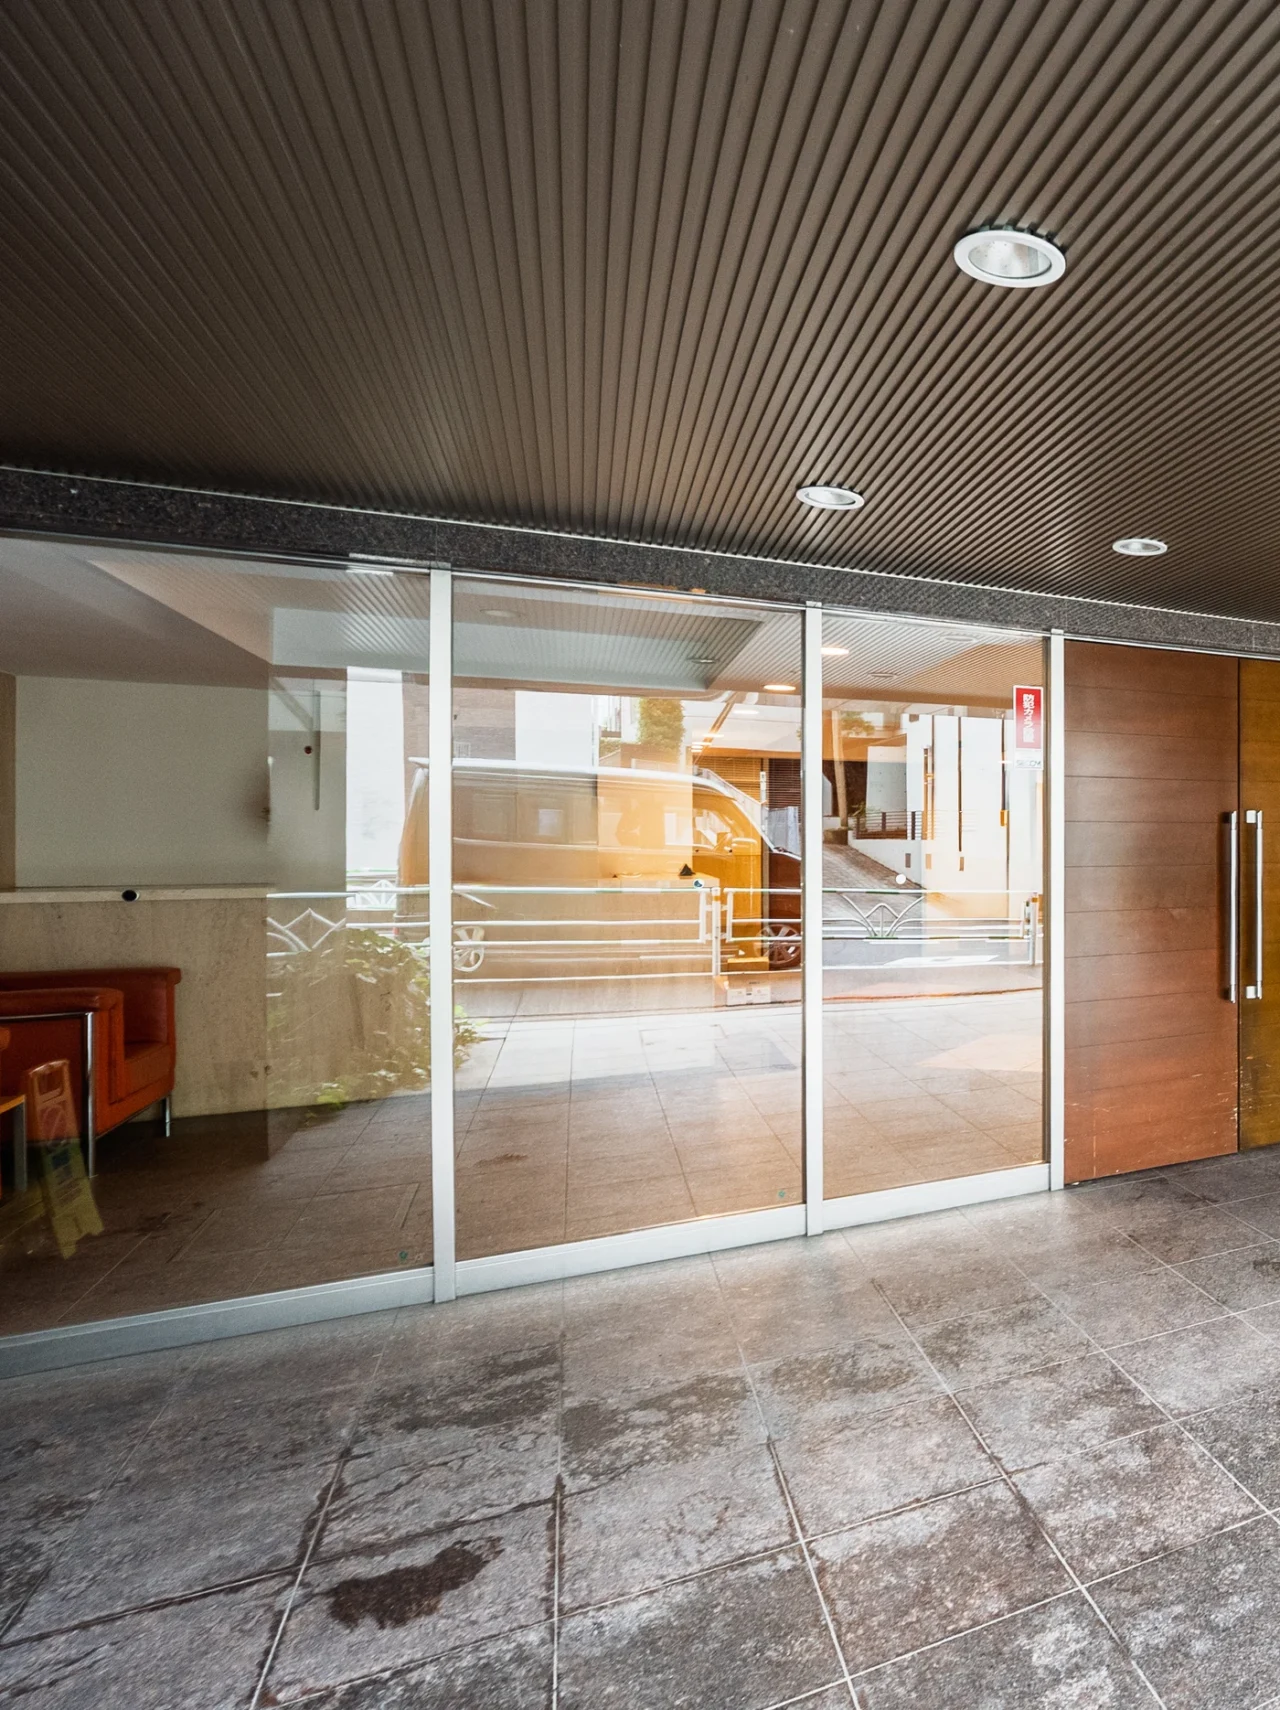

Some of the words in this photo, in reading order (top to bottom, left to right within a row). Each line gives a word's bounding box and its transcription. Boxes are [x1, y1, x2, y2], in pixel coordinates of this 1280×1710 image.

[1022, 693, 1035, 743] 防犯カメラ
